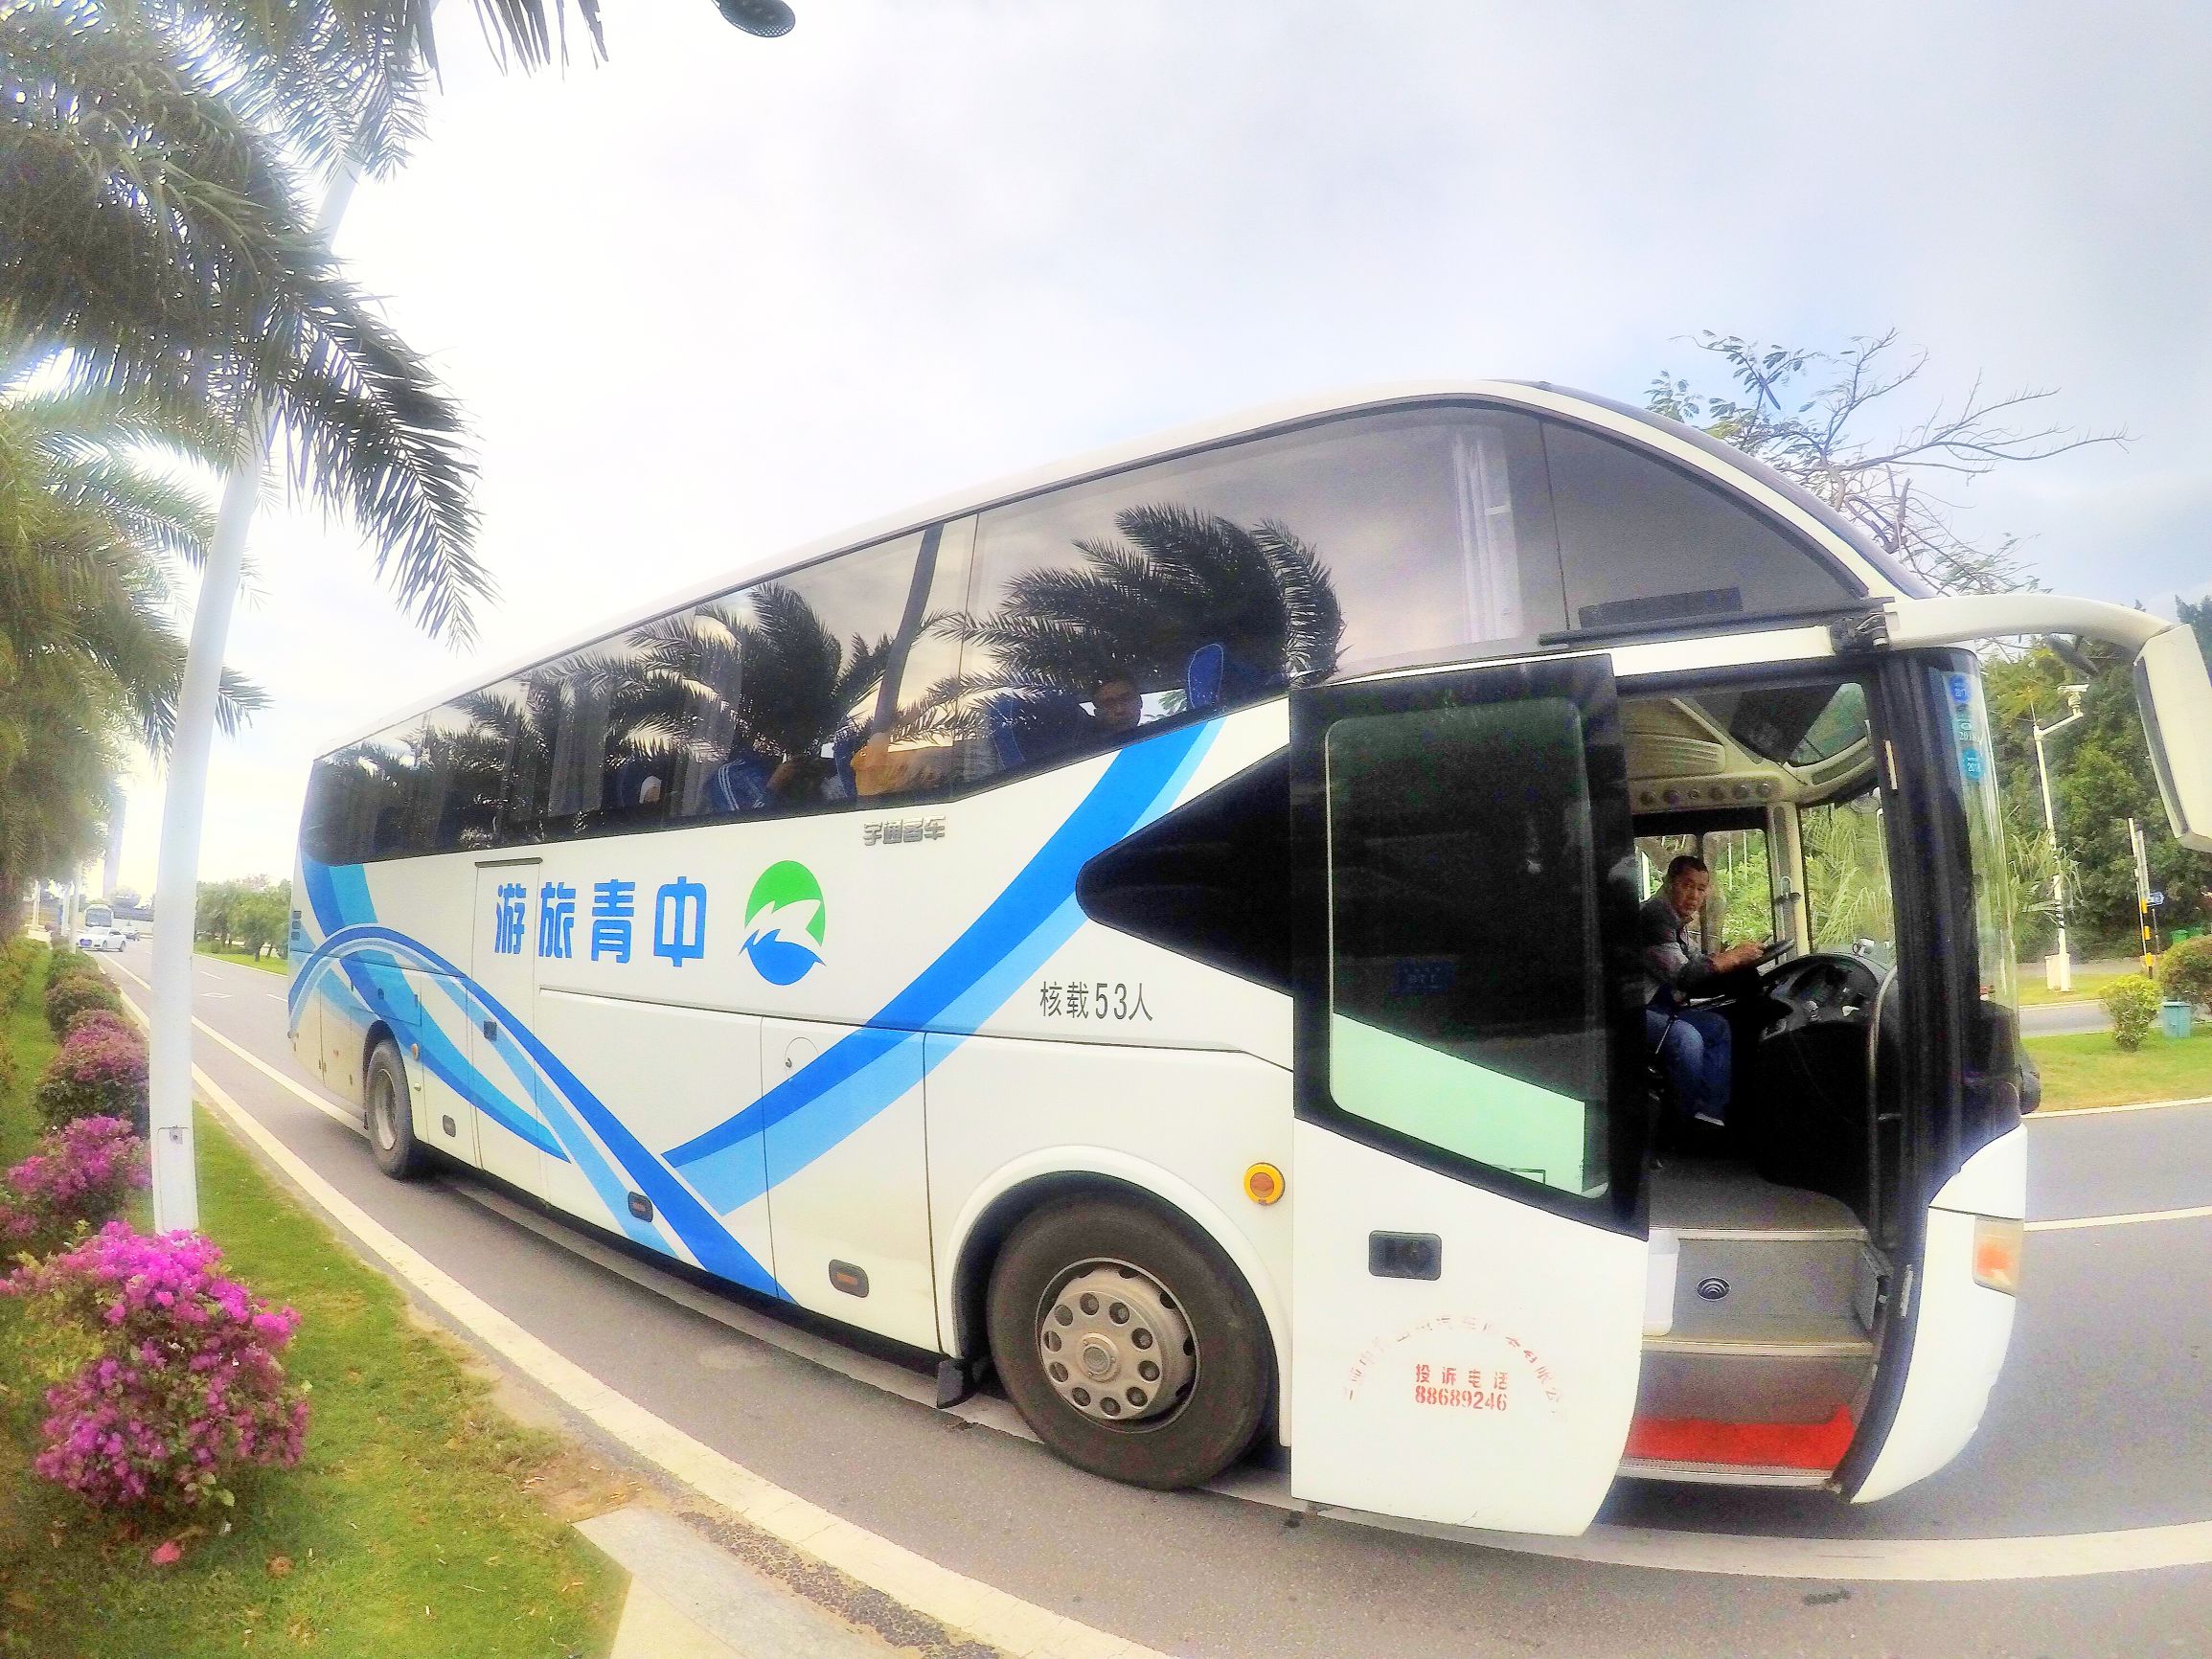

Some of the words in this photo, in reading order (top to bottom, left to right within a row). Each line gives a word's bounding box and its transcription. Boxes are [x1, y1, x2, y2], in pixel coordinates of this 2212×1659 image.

[863, 815, 946, 847] 宇通客车
[1039, 980, 1153, 1022] 核载53人
[1415, 1363, 1509, 1391] 投诉电话
[1414, 1385, 1508, 1412] 88689246
